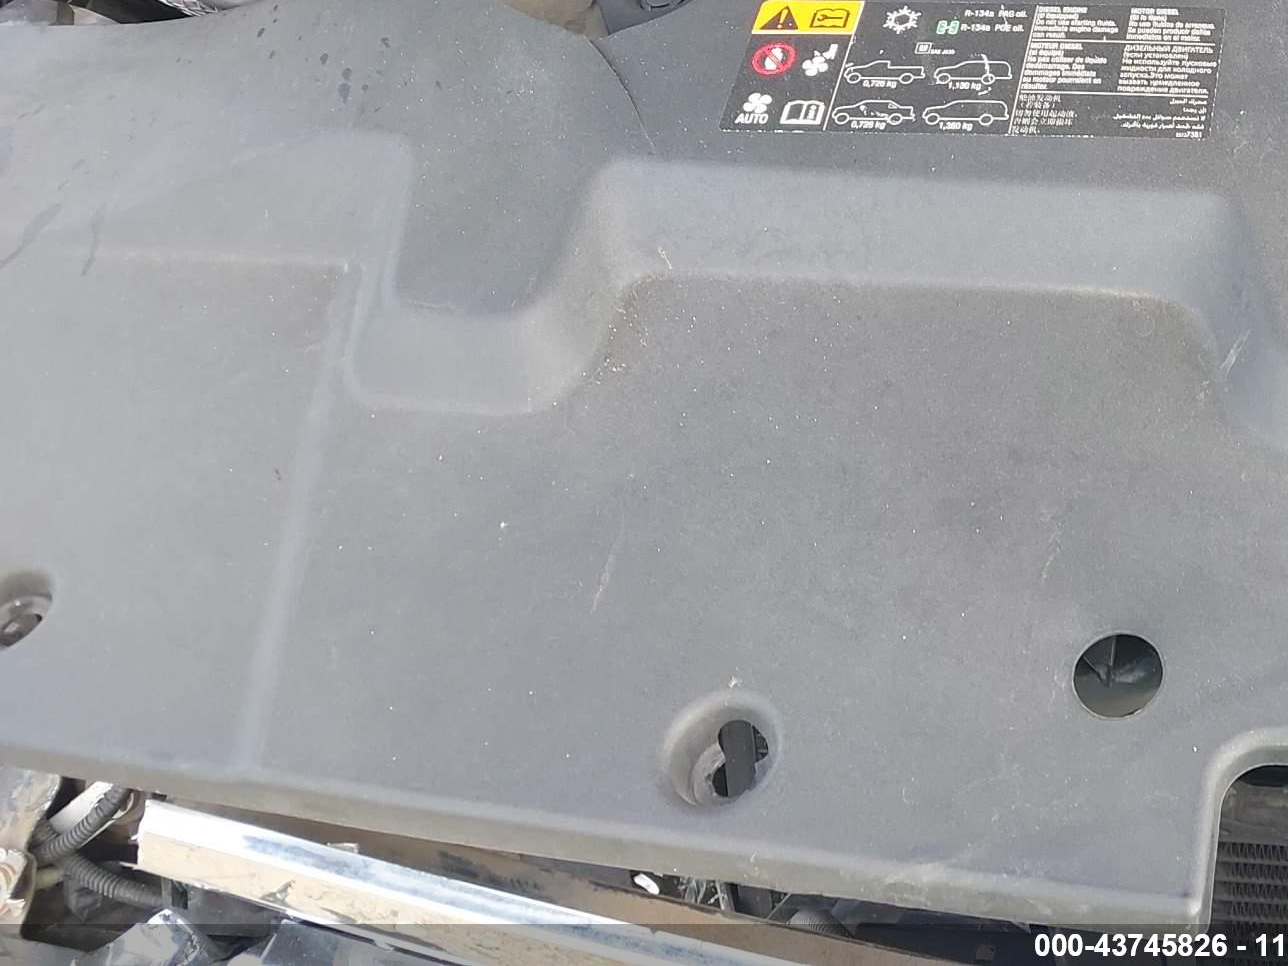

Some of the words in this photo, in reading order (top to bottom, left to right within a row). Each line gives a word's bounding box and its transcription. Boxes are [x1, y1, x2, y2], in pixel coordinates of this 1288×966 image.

[964, 9, 995, 17] R-134a
[998, 10, 1015, 18] PAG
[1016, 10, 1028, 18] oil.
[960, 23, 991, 32] R-134a
[994, 24, 1011, 32] POE
[1172, 46, 1213, 54] ДВИГАТЕЛЬ
[1182, 60, 1217, 68] пусковые
[886, 80, 897, 89] kg
[971, 82, 982, 91] kg
[735, 113, 770, 124] AUTO
[874, 121, 886, 130] kg
[962, 123, 973, 132] kg
